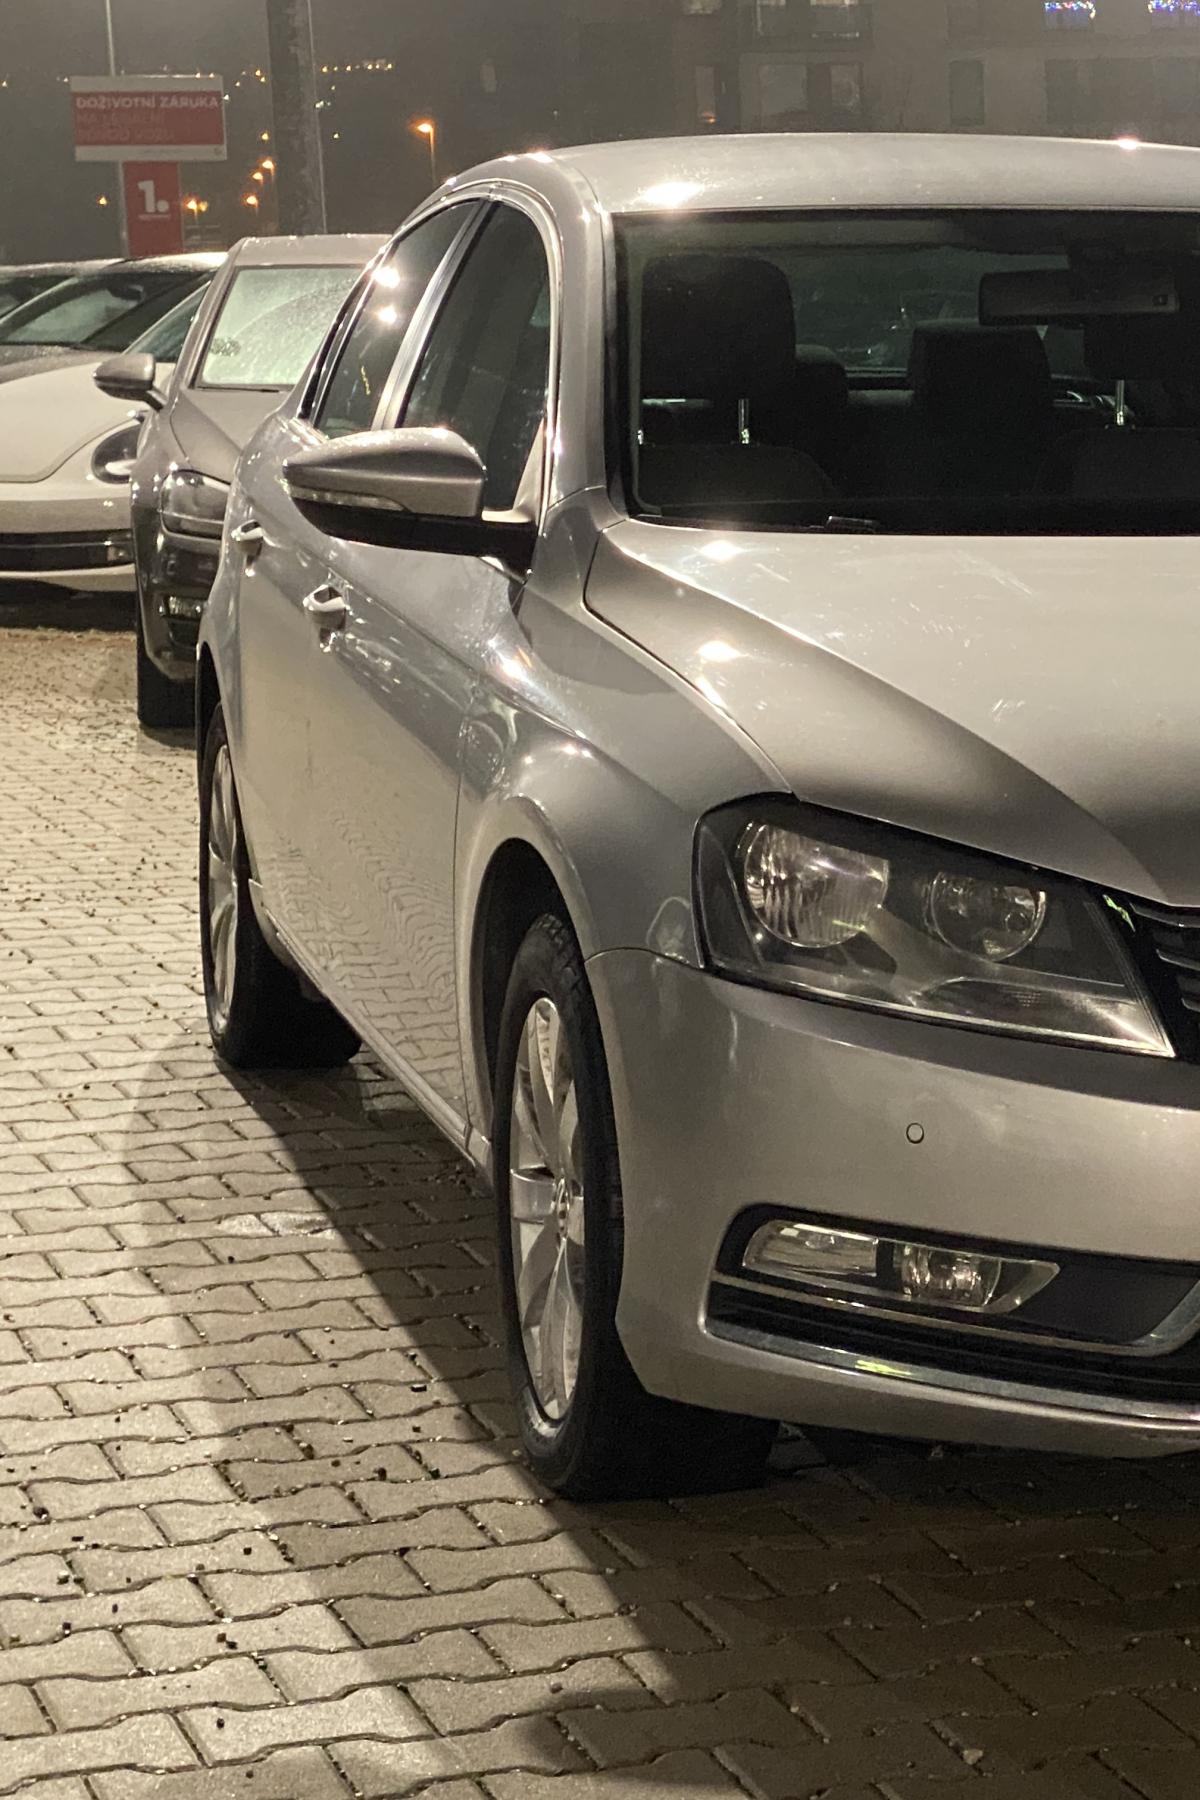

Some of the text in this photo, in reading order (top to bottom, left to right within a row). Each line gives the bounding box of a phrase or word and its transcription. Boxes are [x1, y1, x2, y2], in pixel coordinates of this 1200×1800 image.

[76, 94, 218, 109] DOŽIVOTNÍ ZÁRUKA
[137, 179, 170, 213] 1.
